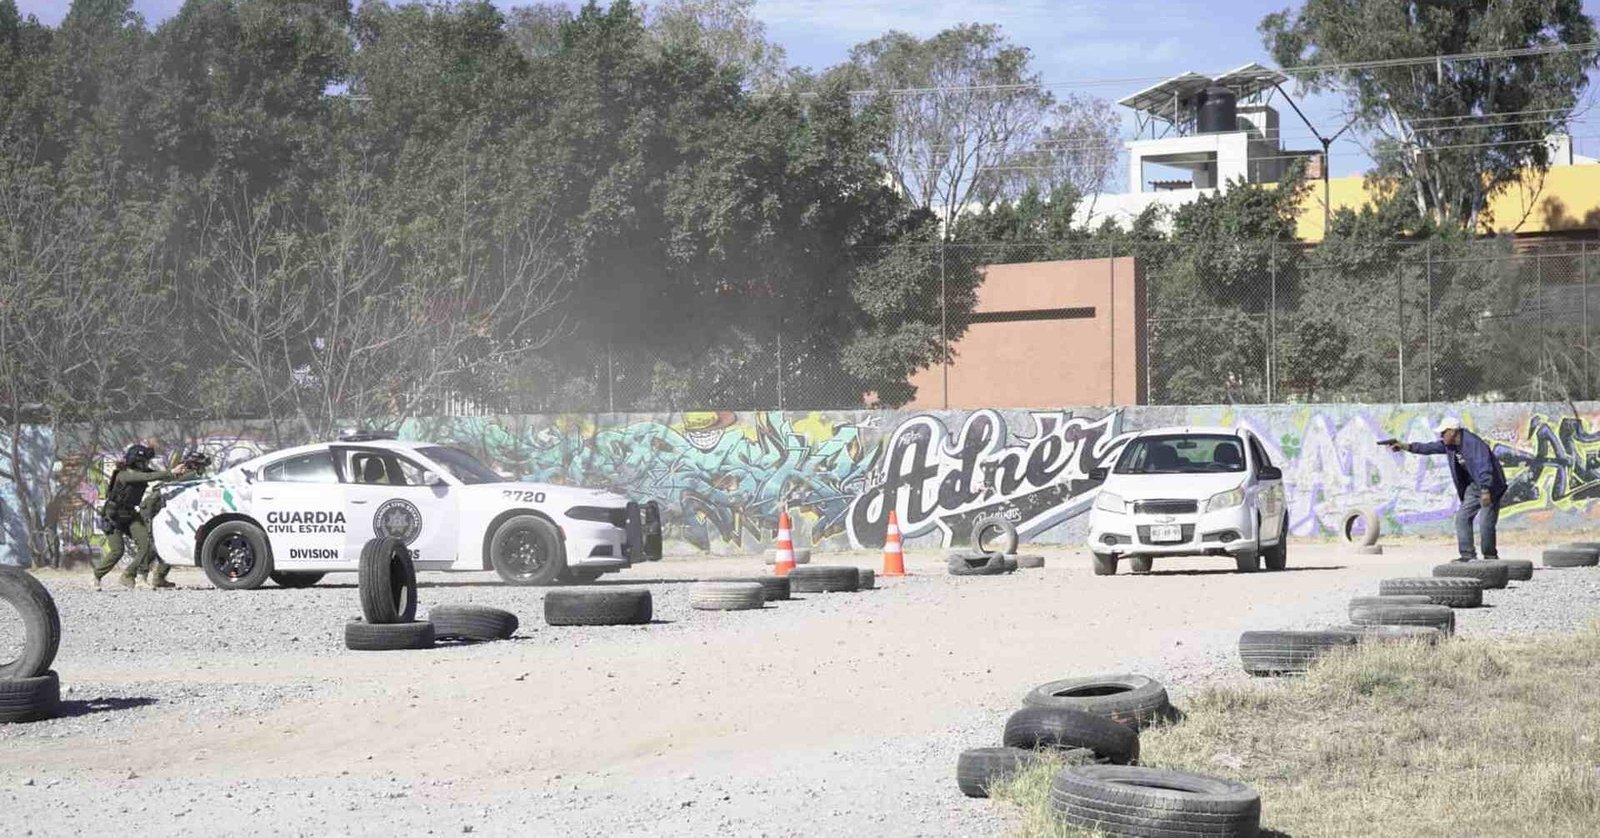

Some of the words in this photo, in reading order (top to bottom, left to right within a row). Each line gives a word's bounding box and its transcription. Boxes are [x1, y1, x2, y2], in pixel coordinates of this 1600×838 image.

[266, 511, 346, 524] GUARDIA
[267, 524, 296, 533] CIVIL
[299, 524, 346, 533] ESTATAL
[289, 549, 338, 559] DIVISION
